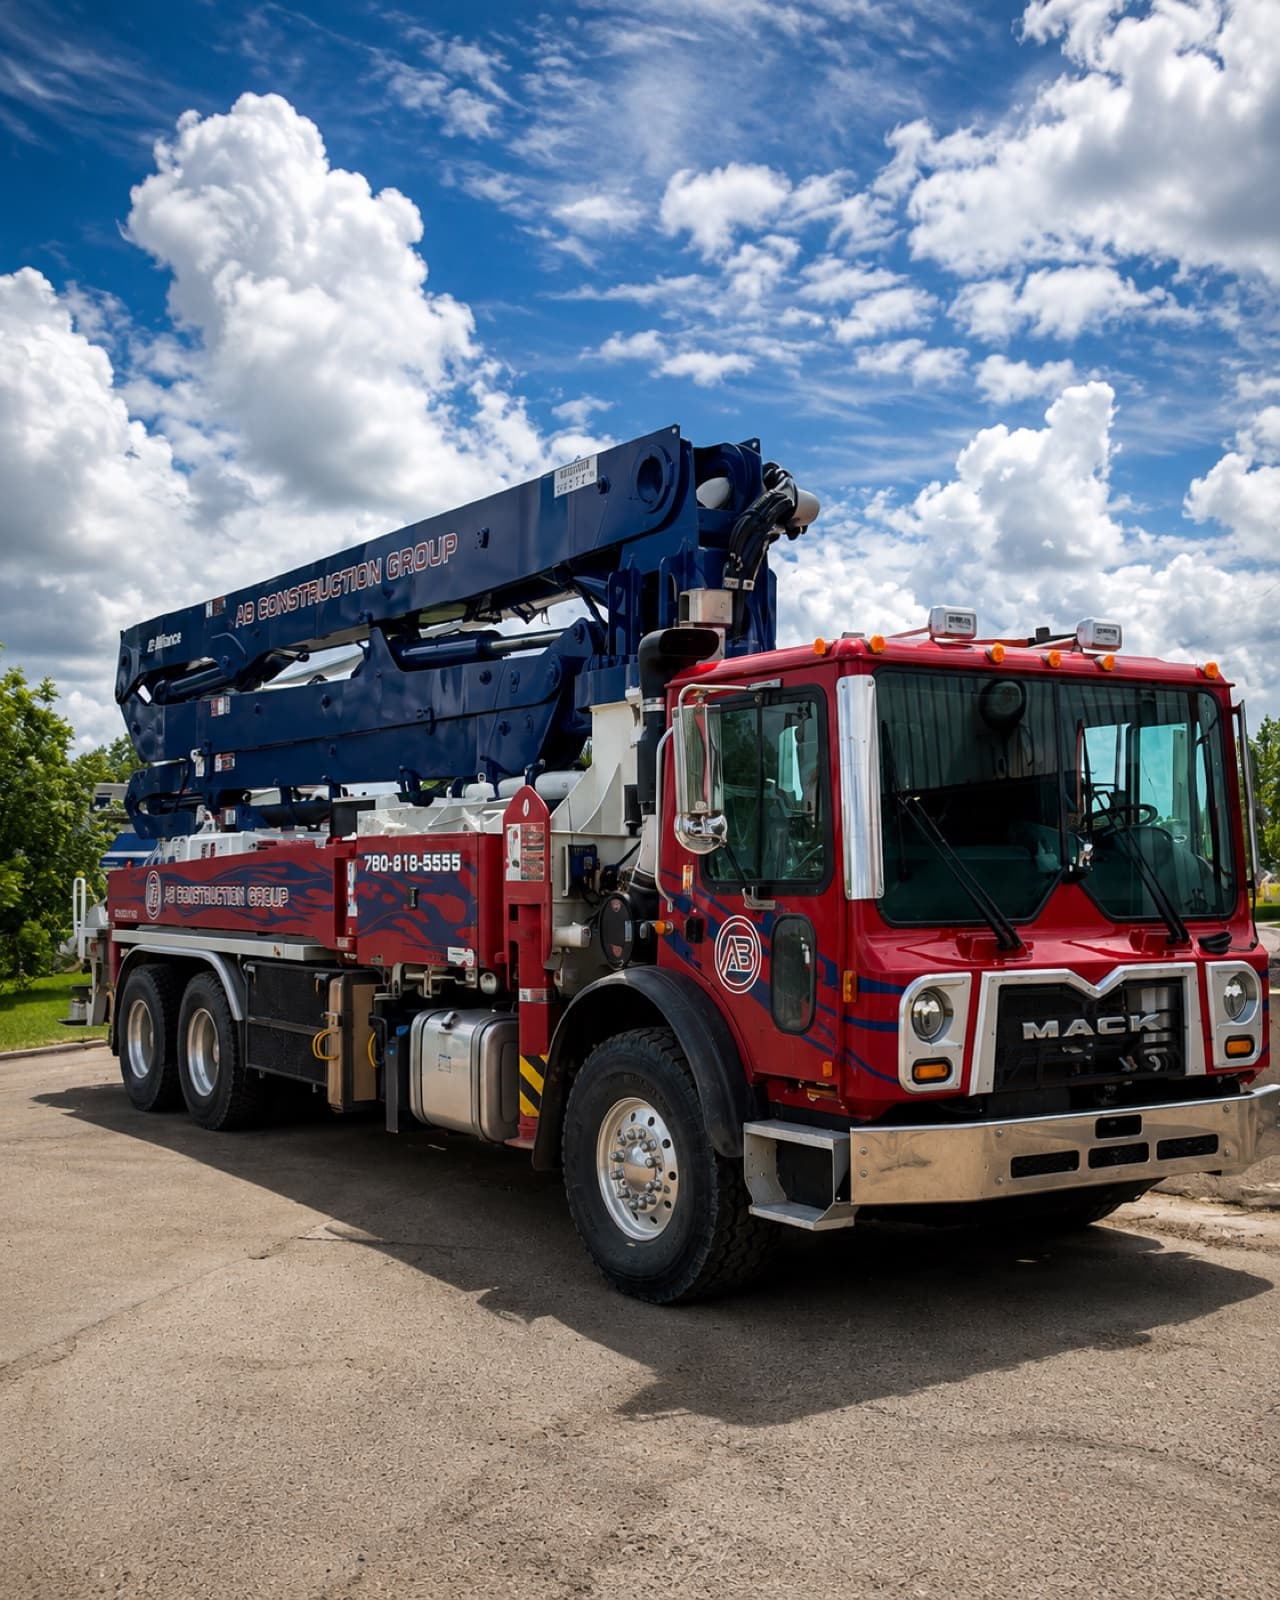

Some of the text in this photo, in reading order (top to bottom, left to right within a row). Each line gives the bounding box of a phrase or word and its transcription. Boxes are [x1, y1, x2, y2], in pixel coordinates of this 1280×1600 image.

[235, 532, 458, 628] AB CONSTRUCTION GROUP
[364, 852, 461, 872] 780-818-5555
[247, 886, 289, 908] GROUP
[720, 935, 755, 977] AB
[1021, 1013, 1162, 1041] MACK
